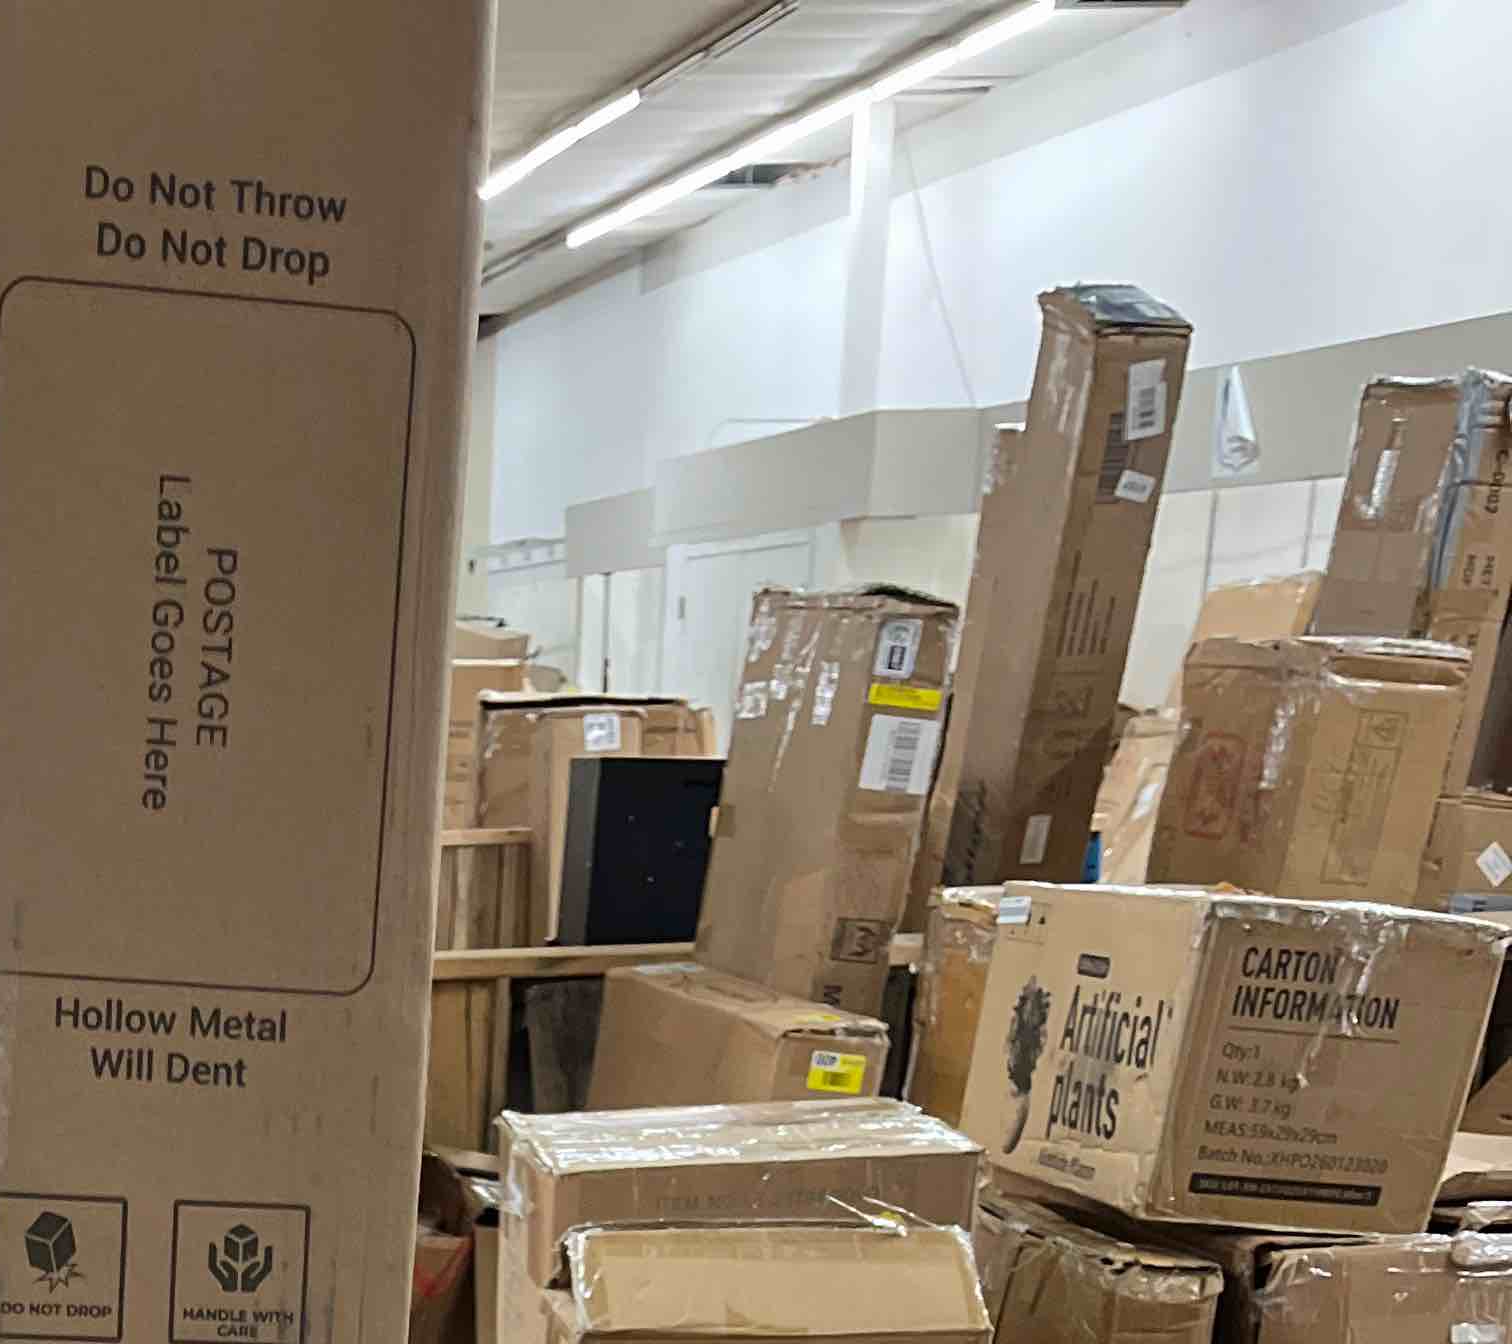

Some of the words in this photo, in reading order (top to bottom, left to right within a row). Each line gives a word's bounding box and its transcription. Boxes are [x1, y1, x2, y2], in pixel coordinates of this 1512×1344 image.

[84, 165, 135, 204] Do
[149, 172, 216, 213] Not
[230, 178, 348, 223] Throw
[96, 222, 146, 260] Do
[162, 229, 228, 270] Not
[242, 236, 331, 286] Drop
[153, 473, 192, 585] Label
[147, 600, 185, 704] Goes
[194, 546, 239, 748] POSTAGE
[141, 715, 178, 812] Here
[1242, 947, 1338, 985] CARTON
[55, 997, 178, 1034] Hollow
[190, 1007, 287, 1044] Metal
[1059, 984, 1165, 1069] Artificial
[1232, 985, 1401, 1030] INFORMATION
[90, 1047, 153, 1082] Will
[166, 1053, 248, 1088] Dent
[1045, 1060, 1120, 1140] plants
[0, 1303, 25, 1317] DO
[29, 1303, 62, 1318] NOT
[66, 1305, 113, 1321] DROP
[183, 1308, 248, 1323] HANDLE
[252, 1310, 294, 1326] WITH
[217, 1323, 259, 1339] CARE
